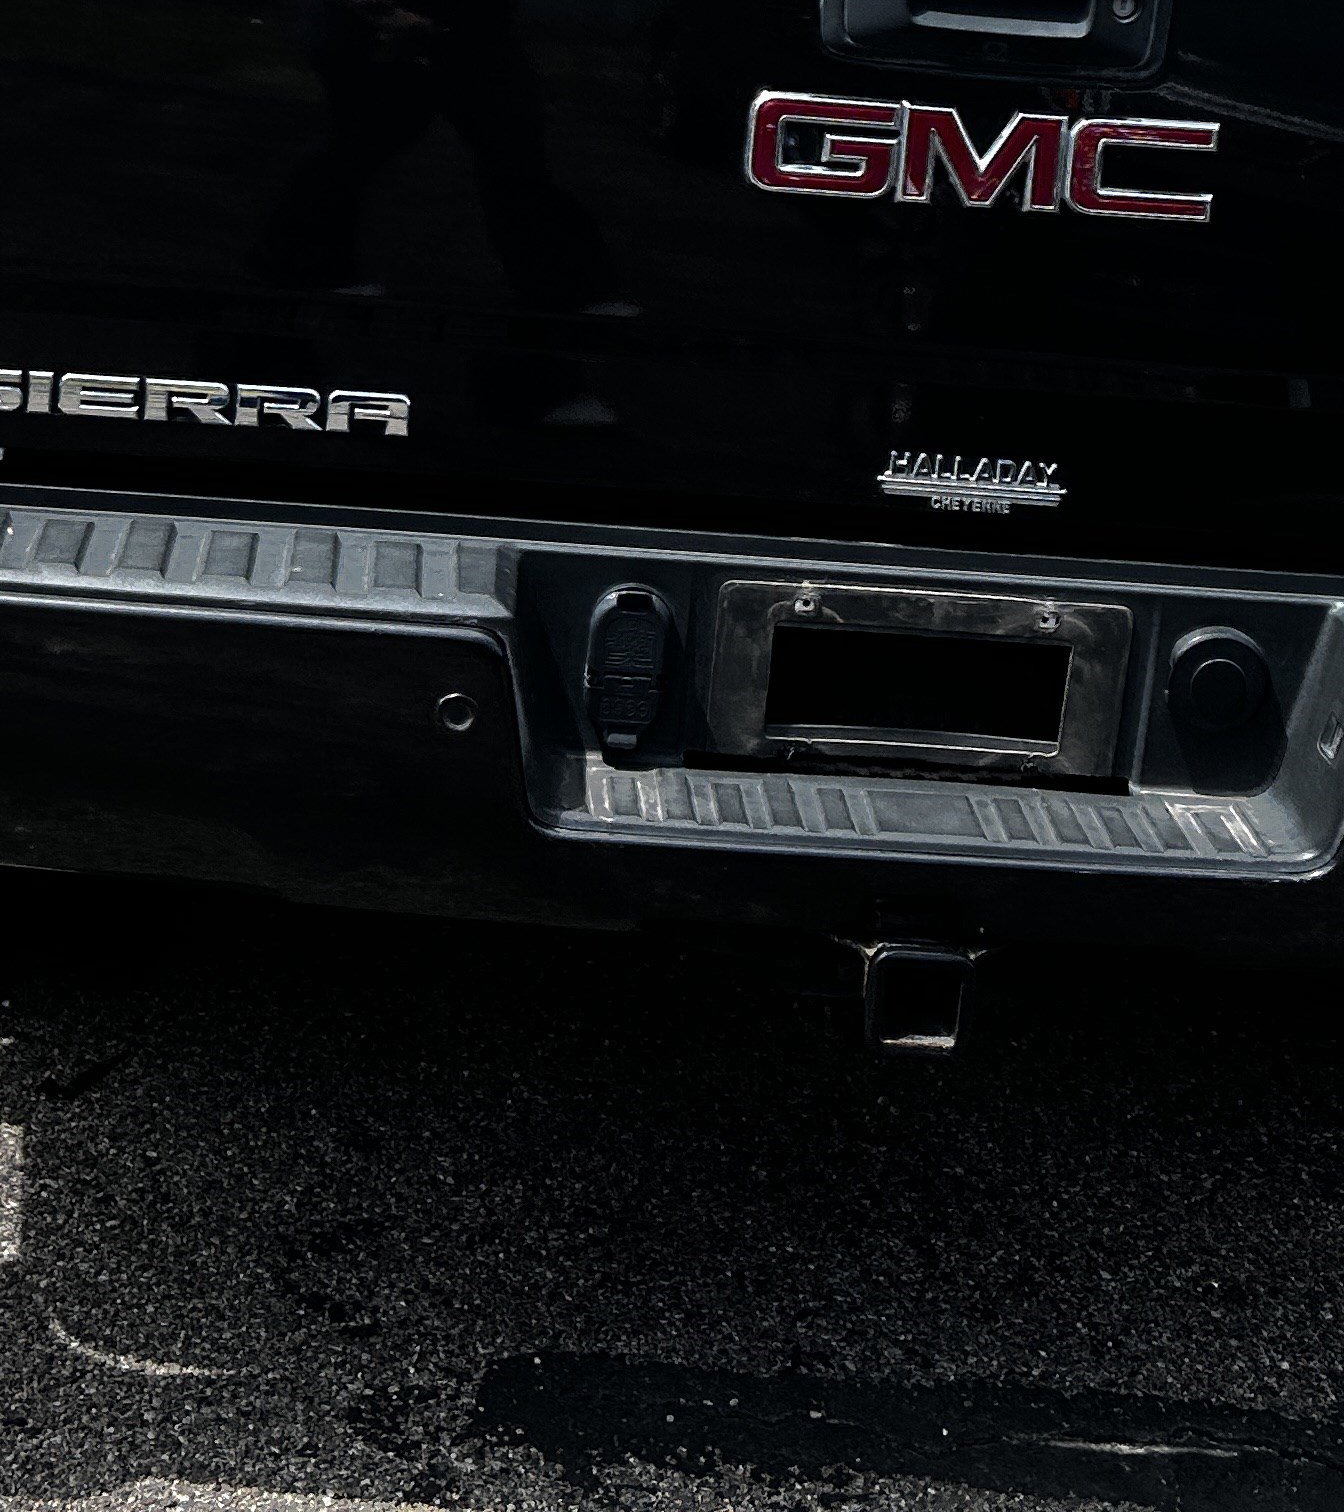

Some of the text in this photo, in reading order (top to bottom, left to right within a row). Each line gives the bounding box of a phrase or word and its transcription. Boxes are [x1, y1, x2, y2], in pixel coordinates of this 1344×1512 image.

[745, 89, 1221, 222] GMC
[883, 450, 1058, 488] HALLADAY
[930, 495, 1012, 515] CHEYENNE
